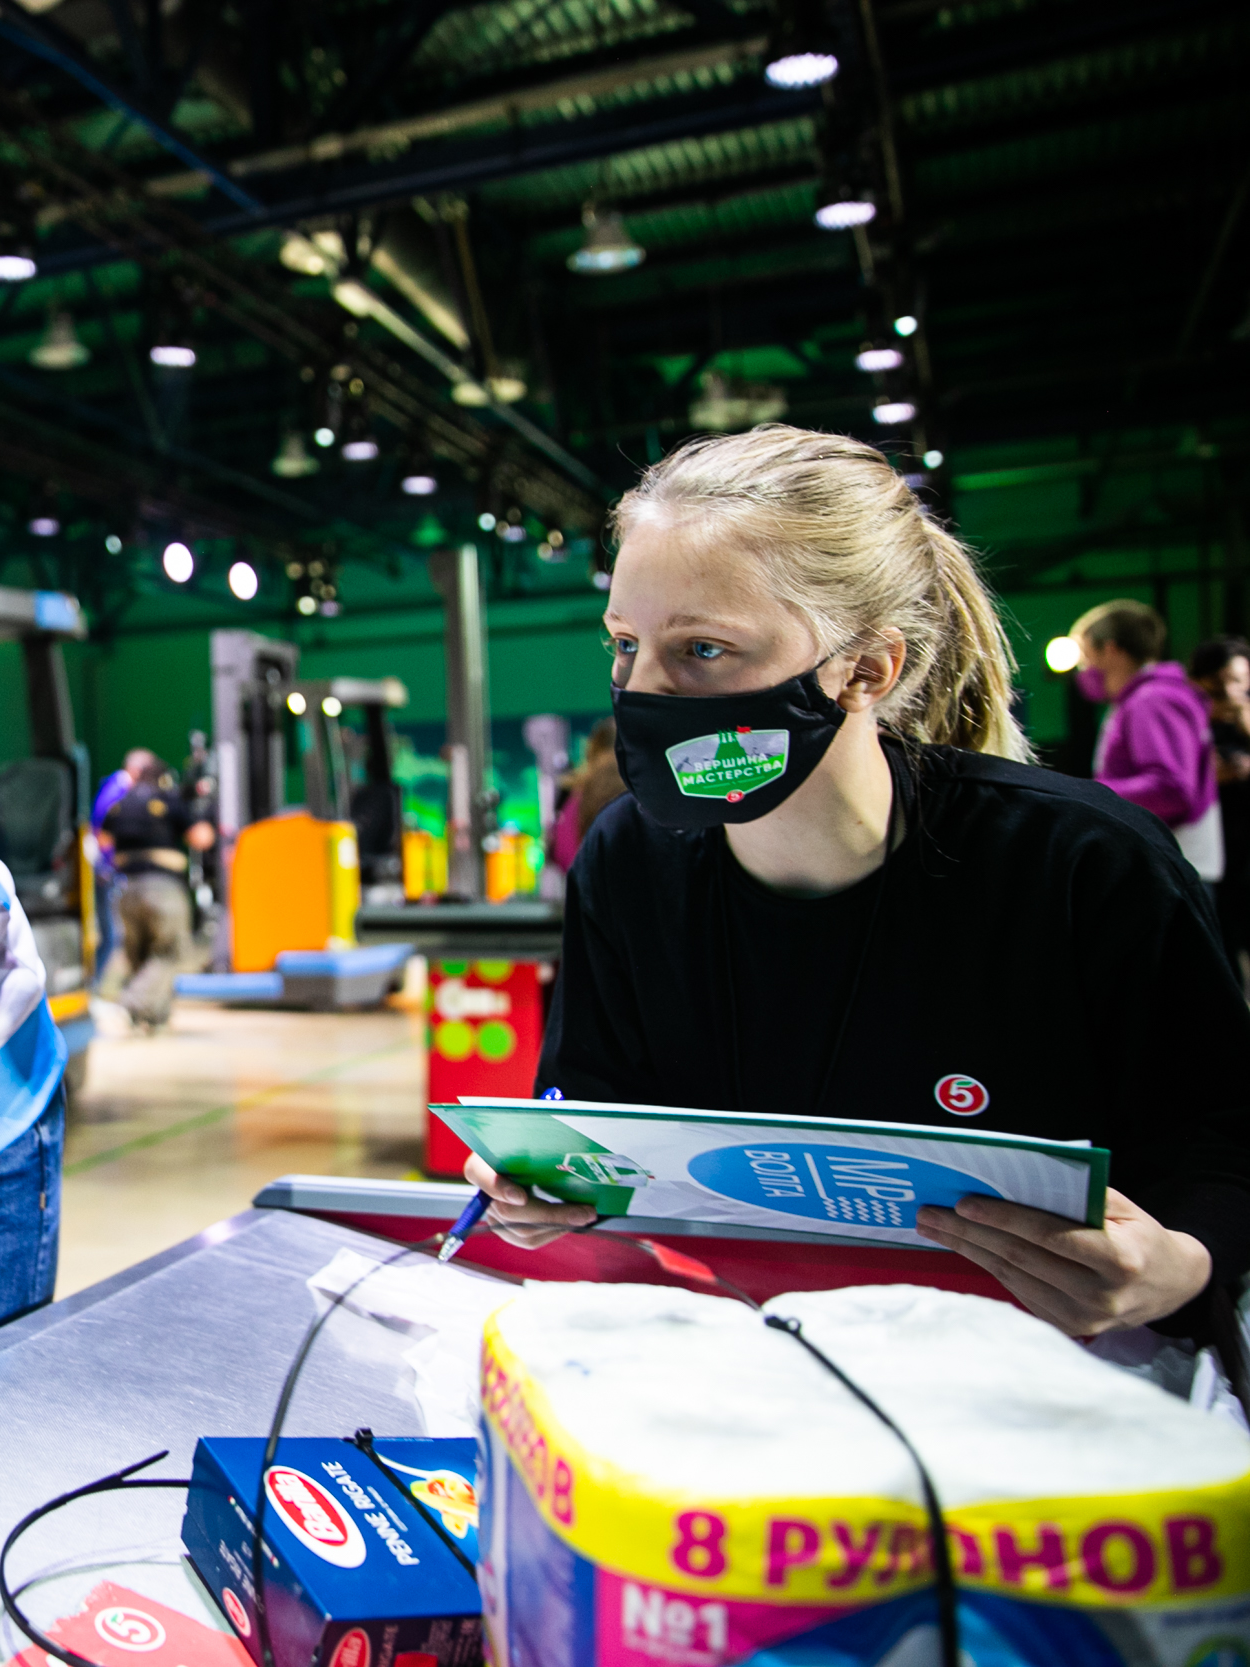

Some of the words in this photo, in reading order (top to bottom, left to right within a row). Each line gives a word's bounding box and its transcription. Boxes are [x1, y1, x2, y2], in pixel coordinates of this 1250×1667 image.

[682, 760, 783, 786] МАСТЕРСТВА
[693, 753, 769, 772] ВЕРШИНА
[949, 1079, 975, 1109] 5
[743, 1149, 807, 1198] ВОЛГА
[274, 1473, 346, 1541] Barilla
[320, 1460, 376, 1511] RIGATE
[363, 1511, 421, 1566] PENNE
[671, 1510, 728, 1580] 8
[104, 1610, 152, 1644] 5
